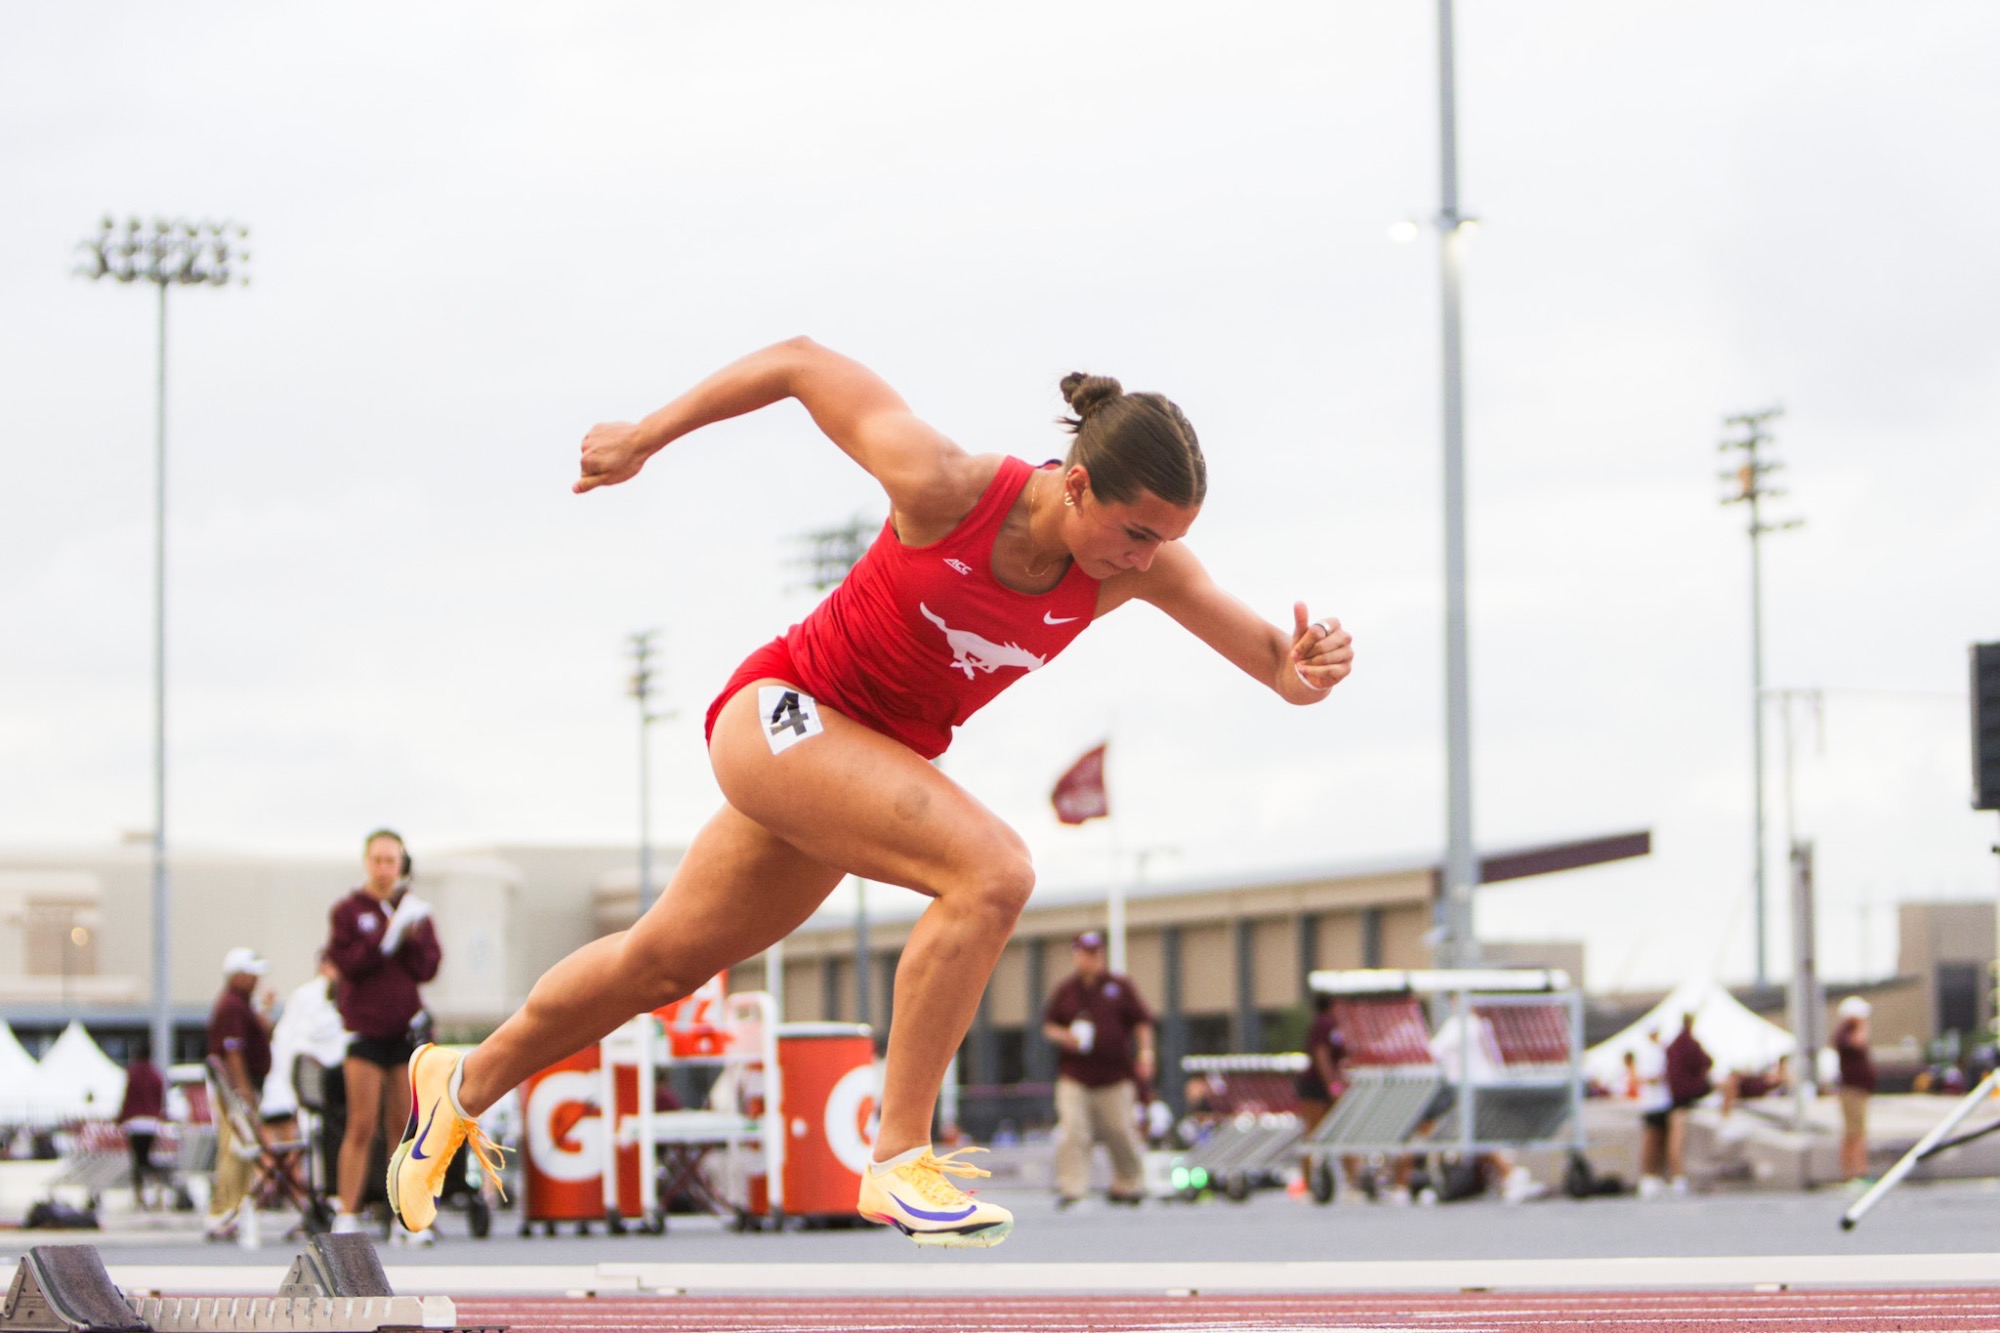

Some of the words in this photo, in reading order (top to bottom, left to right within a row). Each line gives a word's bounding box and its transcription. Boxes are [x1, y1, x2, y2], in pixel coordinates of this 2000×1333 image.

[943, 558, 972, 575] ACC
[769, 691, 809, 736] 4
[526, 1070, 606, 1182] G
